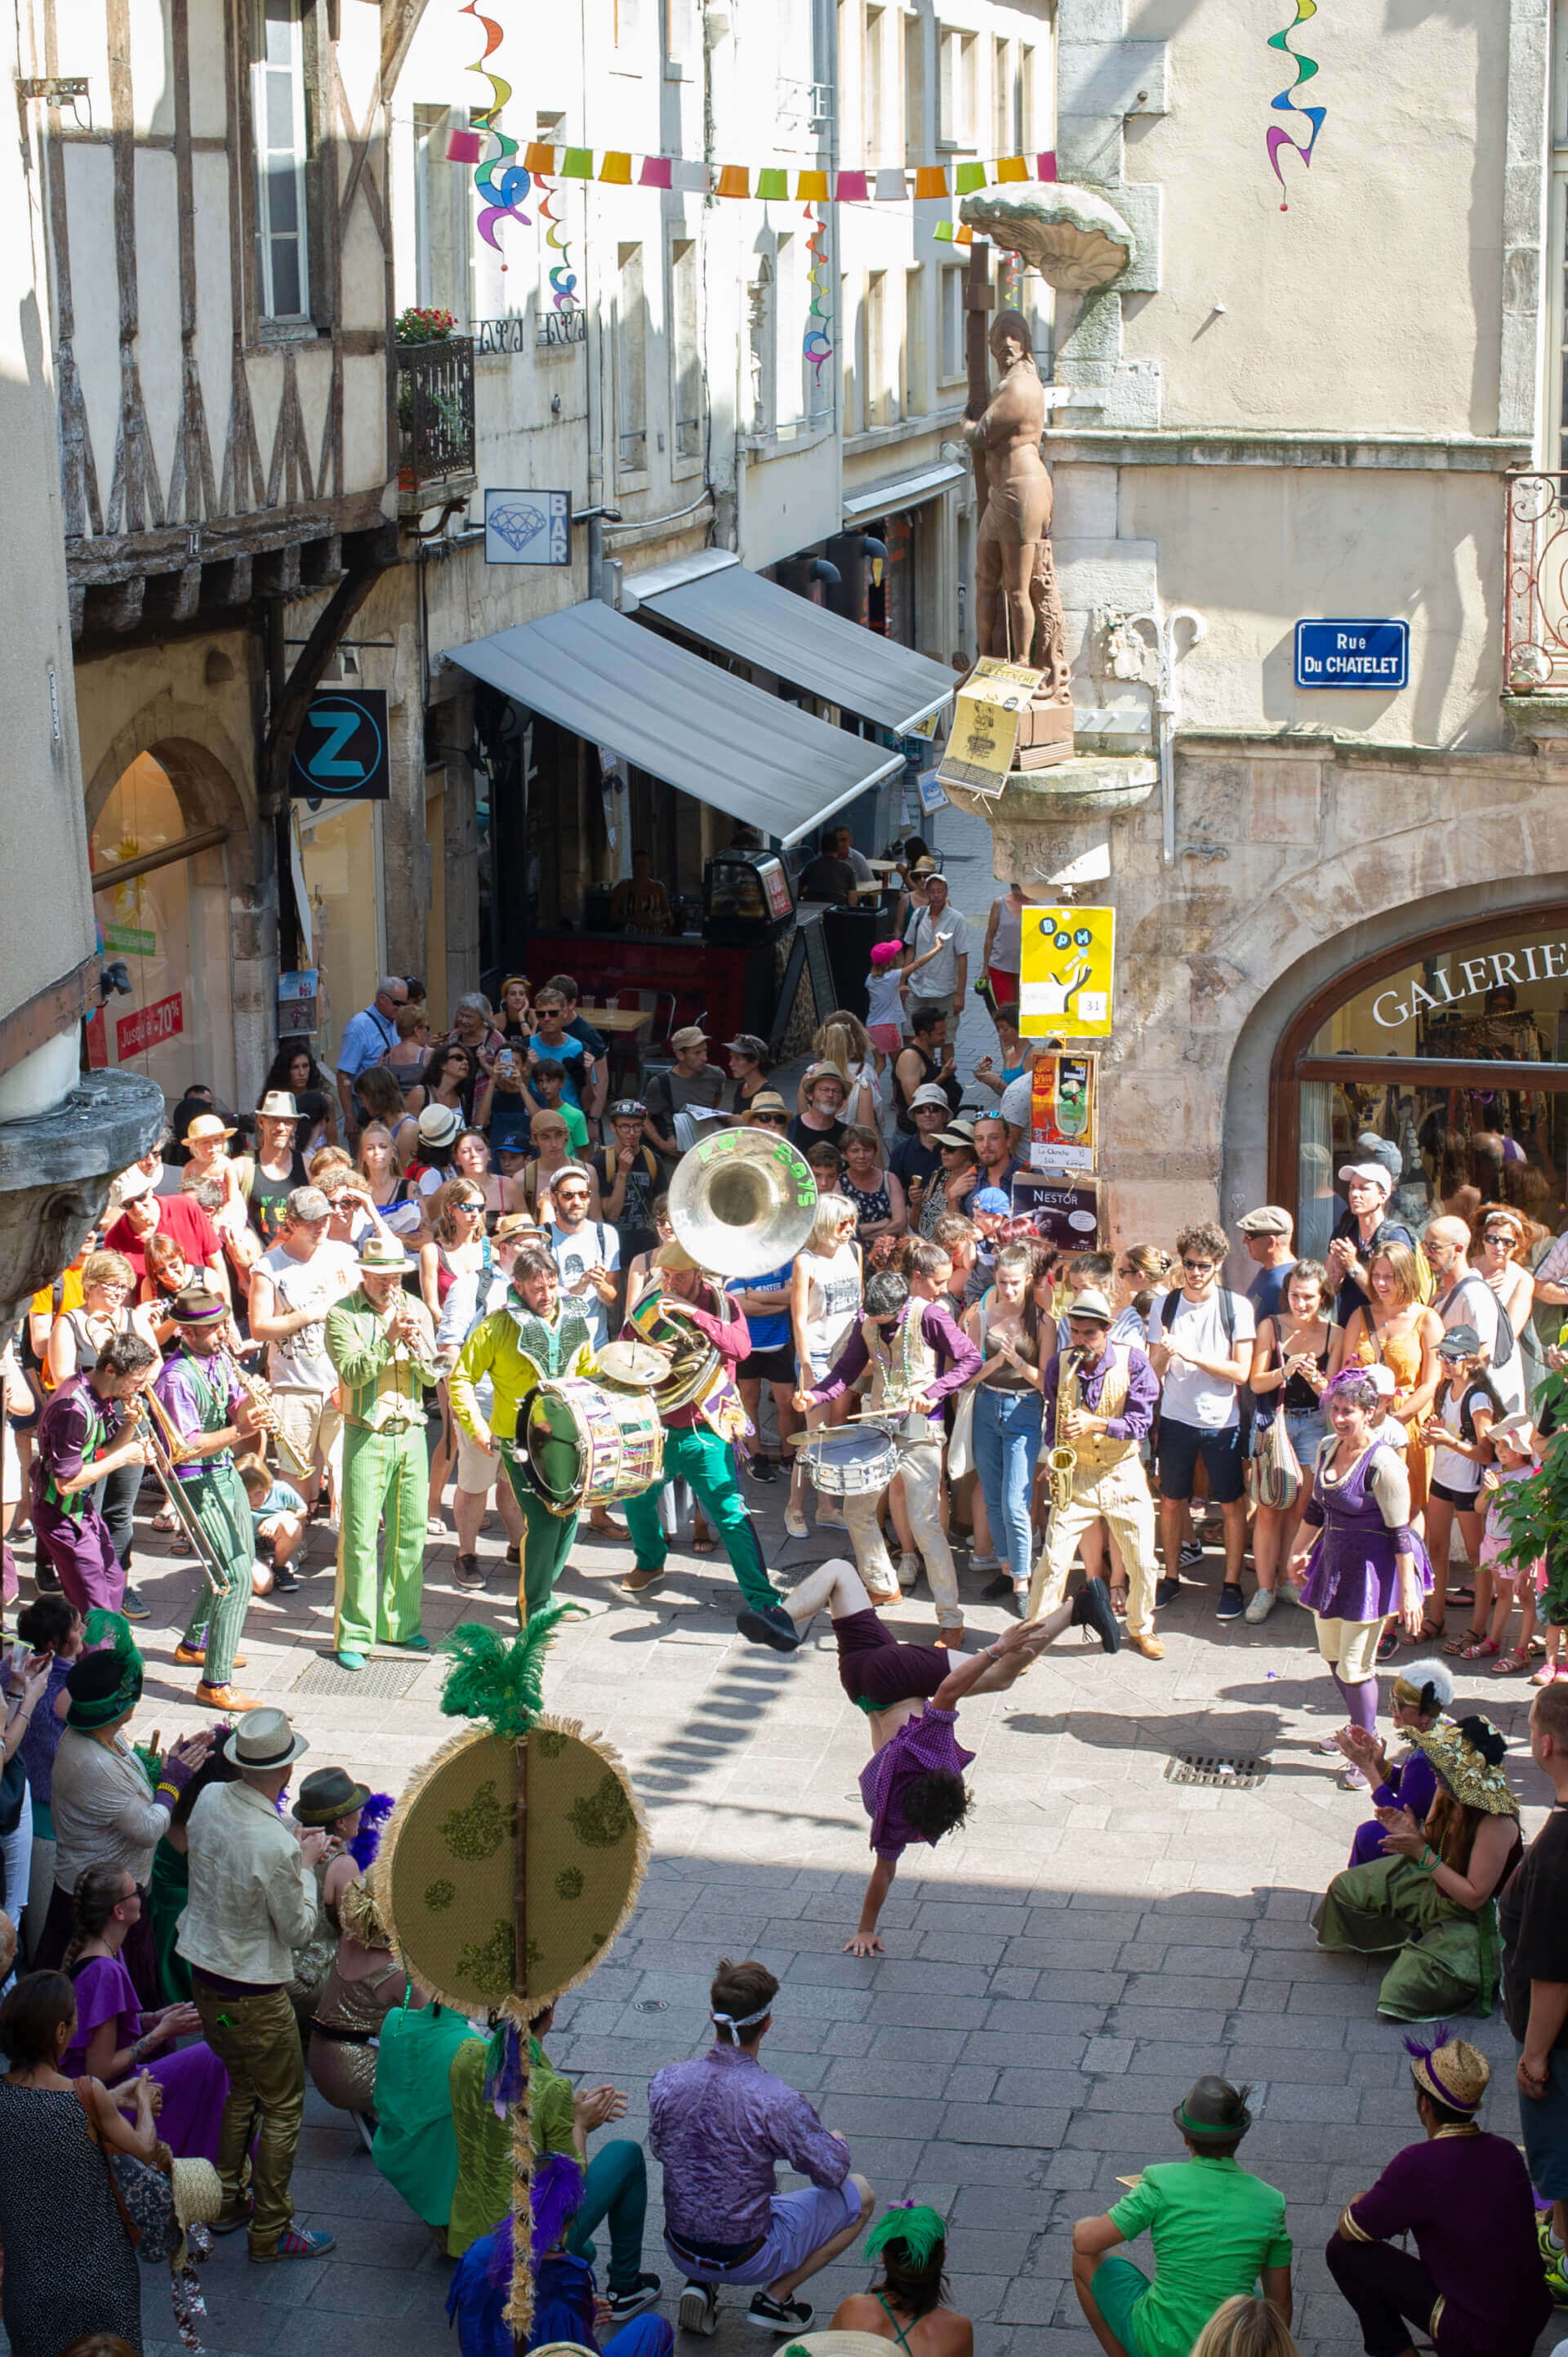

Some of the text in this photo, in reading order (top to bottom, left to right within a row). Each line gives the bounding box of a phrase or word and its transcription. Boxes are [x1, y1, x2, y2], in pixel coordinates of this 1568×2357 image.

[550, 494, 568, 563] BAR
[1337, 633, 1366, 650] Rue
[1304, 657, 1398, 674] Du CHATELET
[308, 711, 366, 777] Z
[1372, 942, 1568, 1027] GALERIE
[1033, 1189, 1078, 1205] NESTOR
